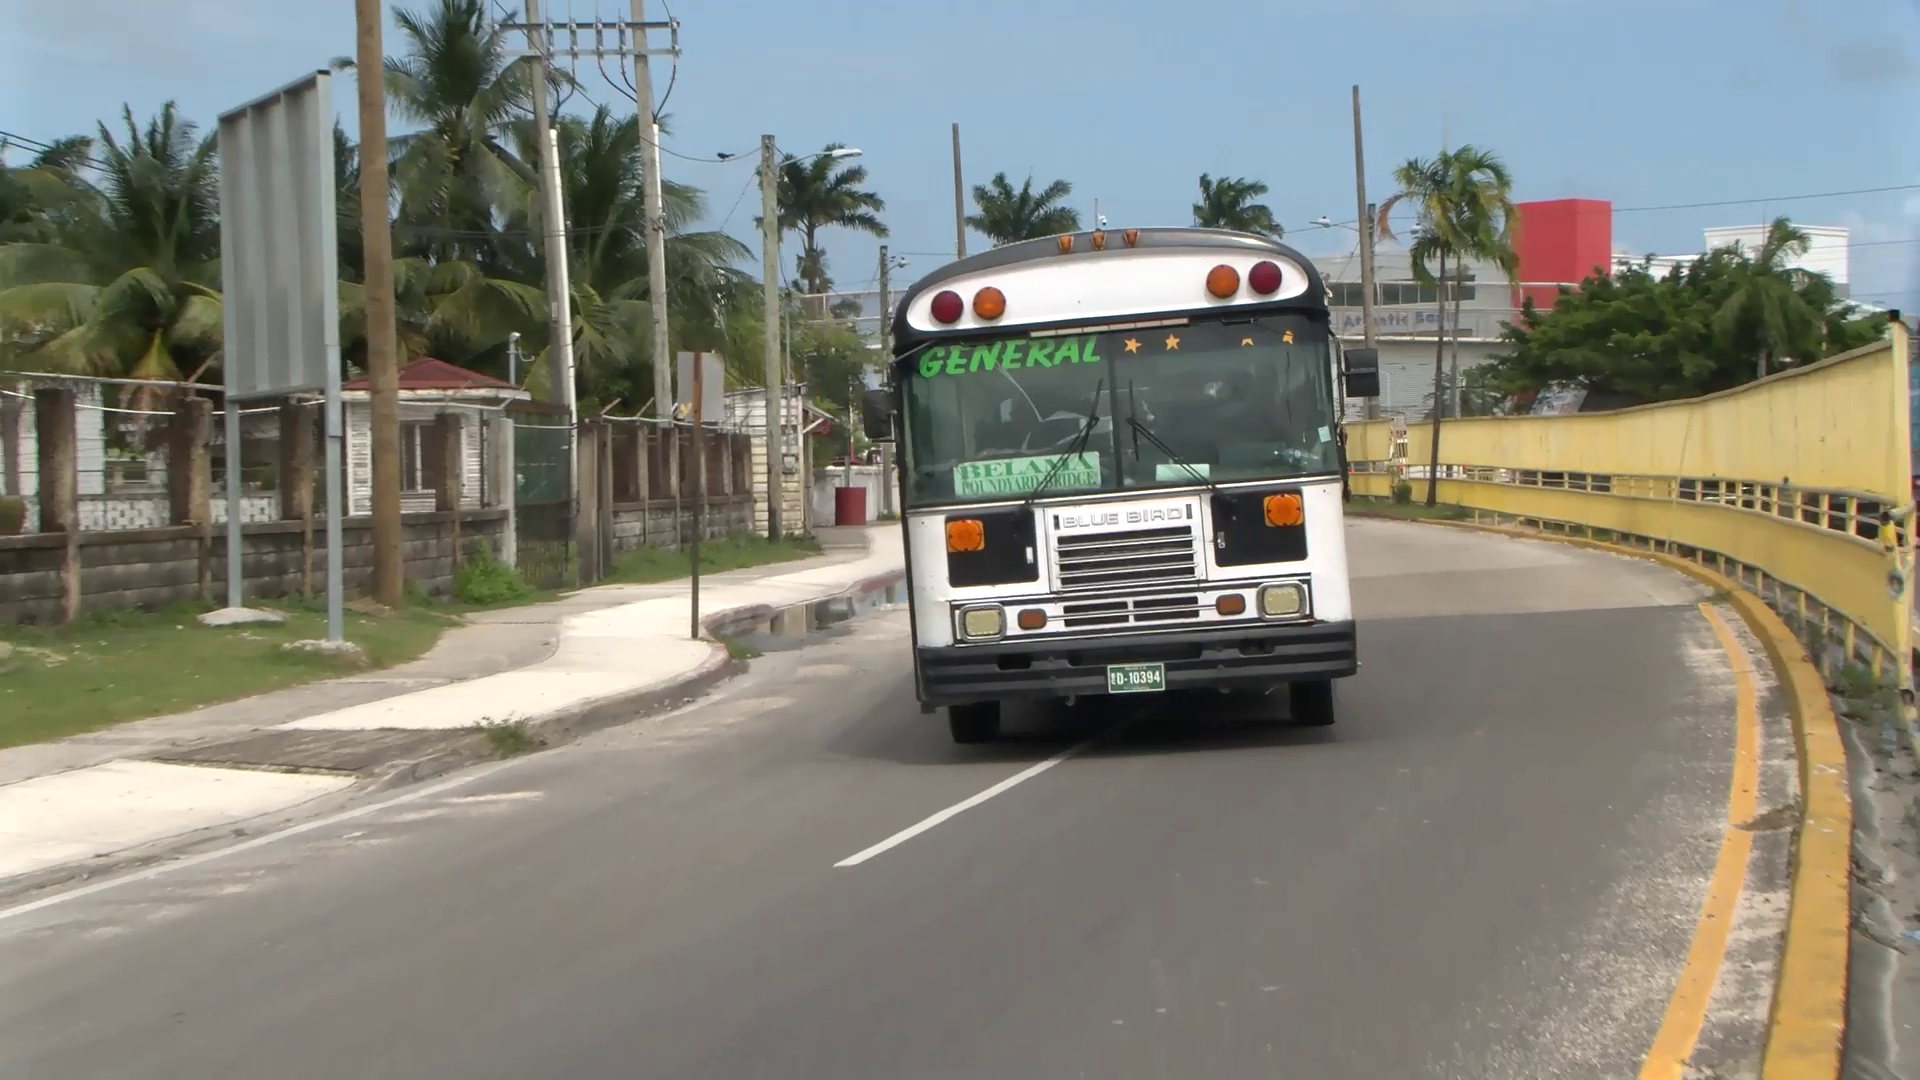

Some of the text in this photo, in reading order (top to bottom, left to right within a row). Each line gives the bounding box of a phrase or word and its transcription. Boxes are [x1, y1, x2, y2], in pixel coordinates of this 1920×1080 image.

[919, 336, 1101, 378] GENERAL
[961, 457, 1094, 479] BELAMA
[962, 475, 1040, 495] POUNDYARD
[1063, 508, 1182, 528] BLUE BIRD
[1116, 671, 1160, 685] D-10394
